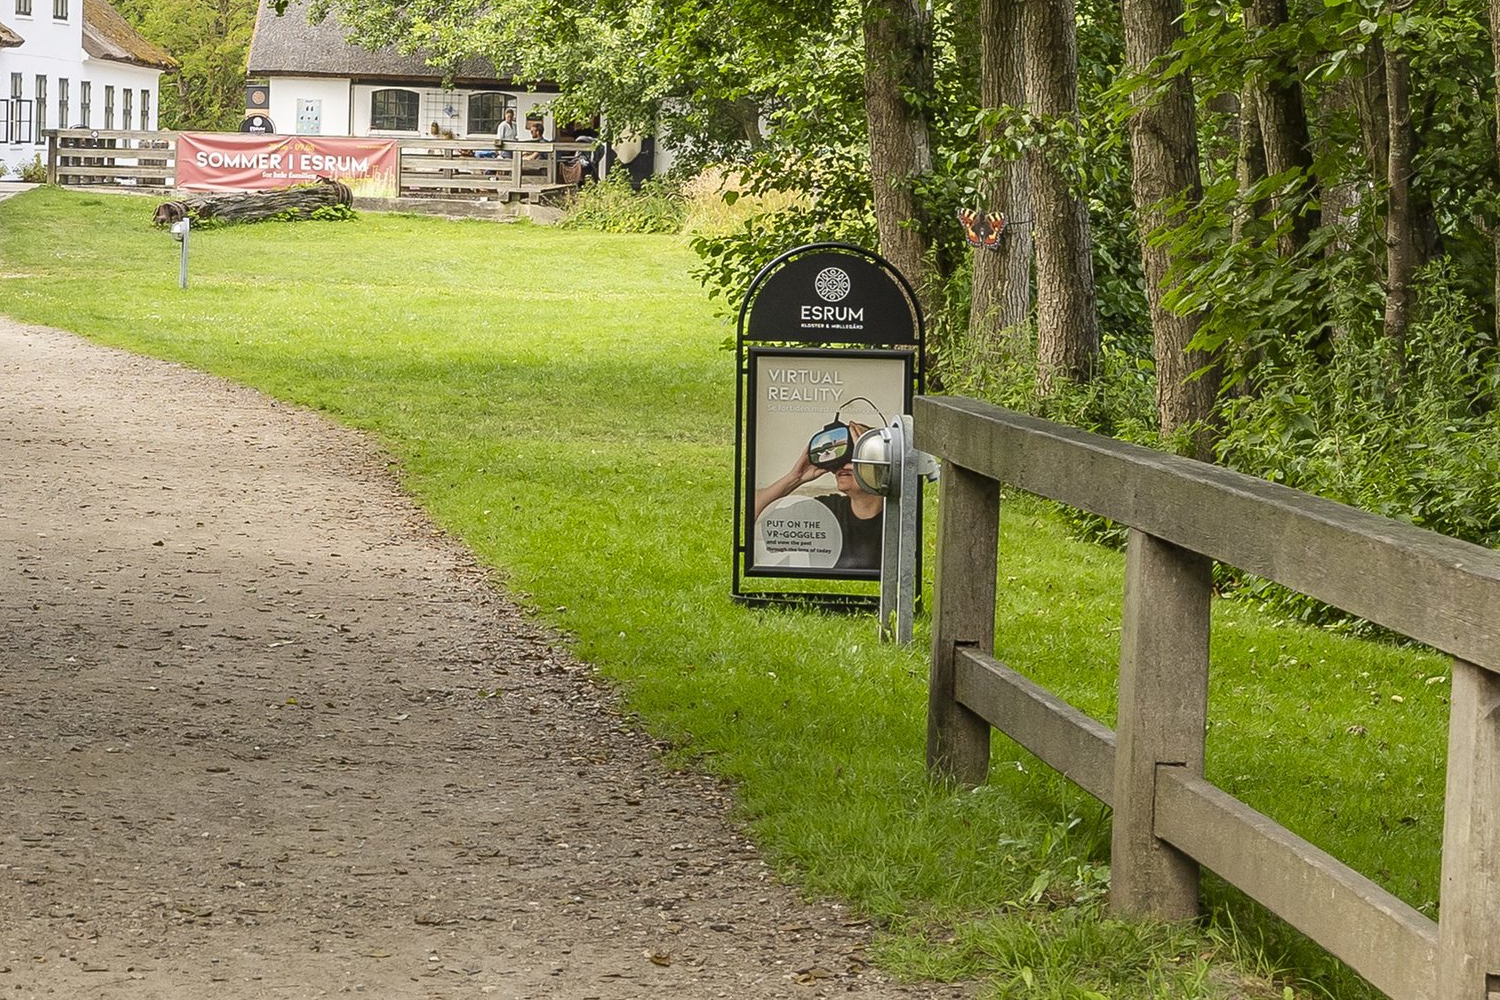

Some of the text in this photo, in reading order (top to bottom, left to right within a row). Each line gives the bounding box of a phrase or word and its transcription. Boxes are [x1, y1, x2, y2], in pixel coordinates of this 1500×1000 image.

[196, 152, 368, 172] SOMMER I ESRUM
[801, 305, 864, 321] ESRUM
[768, 369, 844, 384] VIRTUAL
[768, 386, 843, 401] REALITY
[787, 520, 801, 528] ON
[804, 521, 821, 529] THE
[766, 530, 826, 539] VR-GOGGLES
